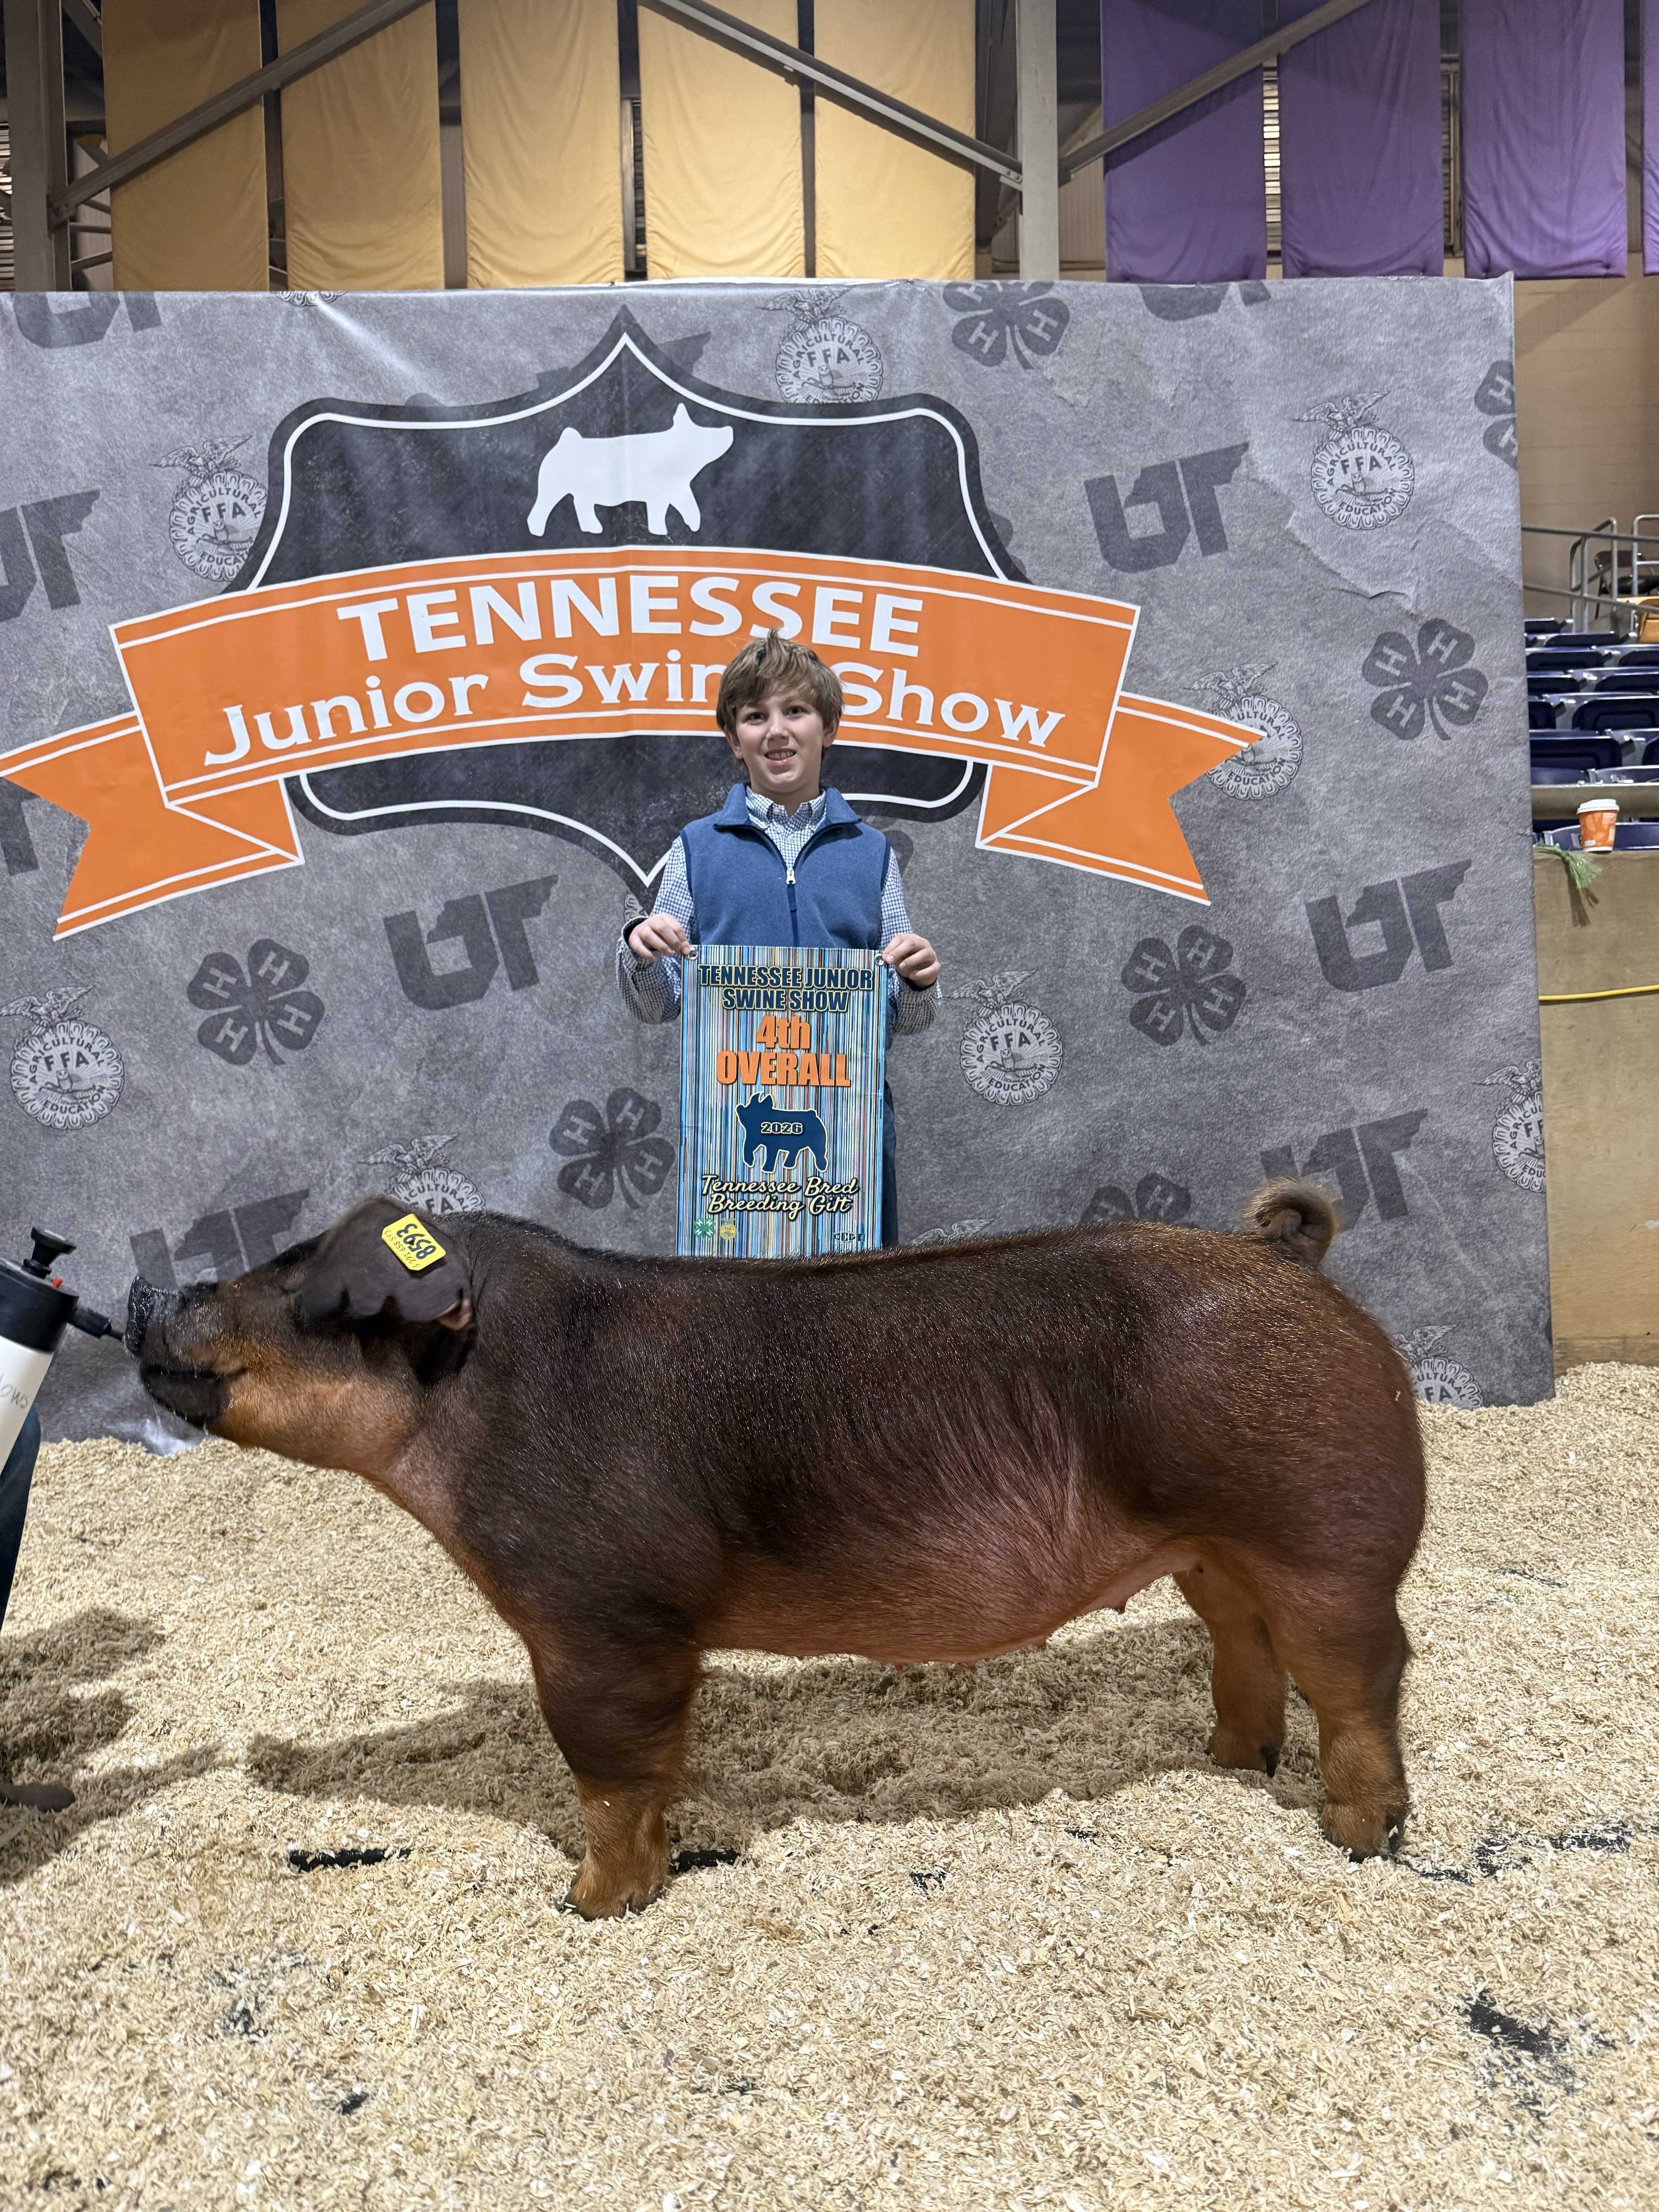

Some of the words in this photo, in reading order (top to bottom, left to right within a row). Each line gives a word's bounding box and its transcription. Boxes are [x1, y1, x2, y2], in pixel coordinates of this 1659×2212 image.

[793, 334, 864, 380] AGRICULTURAL
[807, 348, 850, 368] FFA
[1327, 442, 1396, 485] AGRICULTURAL
[1341, 455, 1382, 474] FFA
[187, 488, 261, 536] AGRICULTURAL
[201, 502, 246, 523] FFA
[1339, 488, 1397, 515] EDUCATION
[200, 551, 249, 565] EDUCAT
[337, 575, 924, 661] TENNESSEE
[204, 674, 489, 767] Junior
[519, 649, 729, 708] Swin
[833, 662, 1066, 748] Show
[1228, 758, 1286, 785] EDUCATION
[698, 965, 802, 988] TENNESSEE
[804, 968, 873, 990] JUNIOR
[722, 988, 786, 1010] SWINE
[789, 990, 849, 1012] SHOW
[756, 1015, 811, 1049] 4th
[976, 1018, 1045, 1063] AGRICULTURAL
[990, 1032, 1031, 1051] FFA
[29, 1037, 105, 1084] AGRICULTURAL
[44, 1051, 89, 1072] FFA
[716, 1050, 851, 1087] OVERALL
[988, 1064, 1046, 1091] EDUCATION
[43, 1085, 106, 1114] EDUCATION
[761, 1121, 803, 1134] 2026
[1510, 1105, 1543, 1149] AGRICUL
[1524, 1119, 1543, 1138] FF
[404, 1184, 469, 1212] ICULTURAL
[702, 1175, 801, 1195] Tennessee
[805, 1176, 860, 1196] Bred
[410, 1198, 454, 1213] FA
[708, 1193, 805, 1221] Breeding
[810, 1195, 853, 1215] Gilt
[394, 1241, 406, 1251] 658
[396, 1223, 436, 1259] 8593
[1415, 1372, 1465, 1400] ULTURAL
[1415, 1386, 1452, 1401] FA
